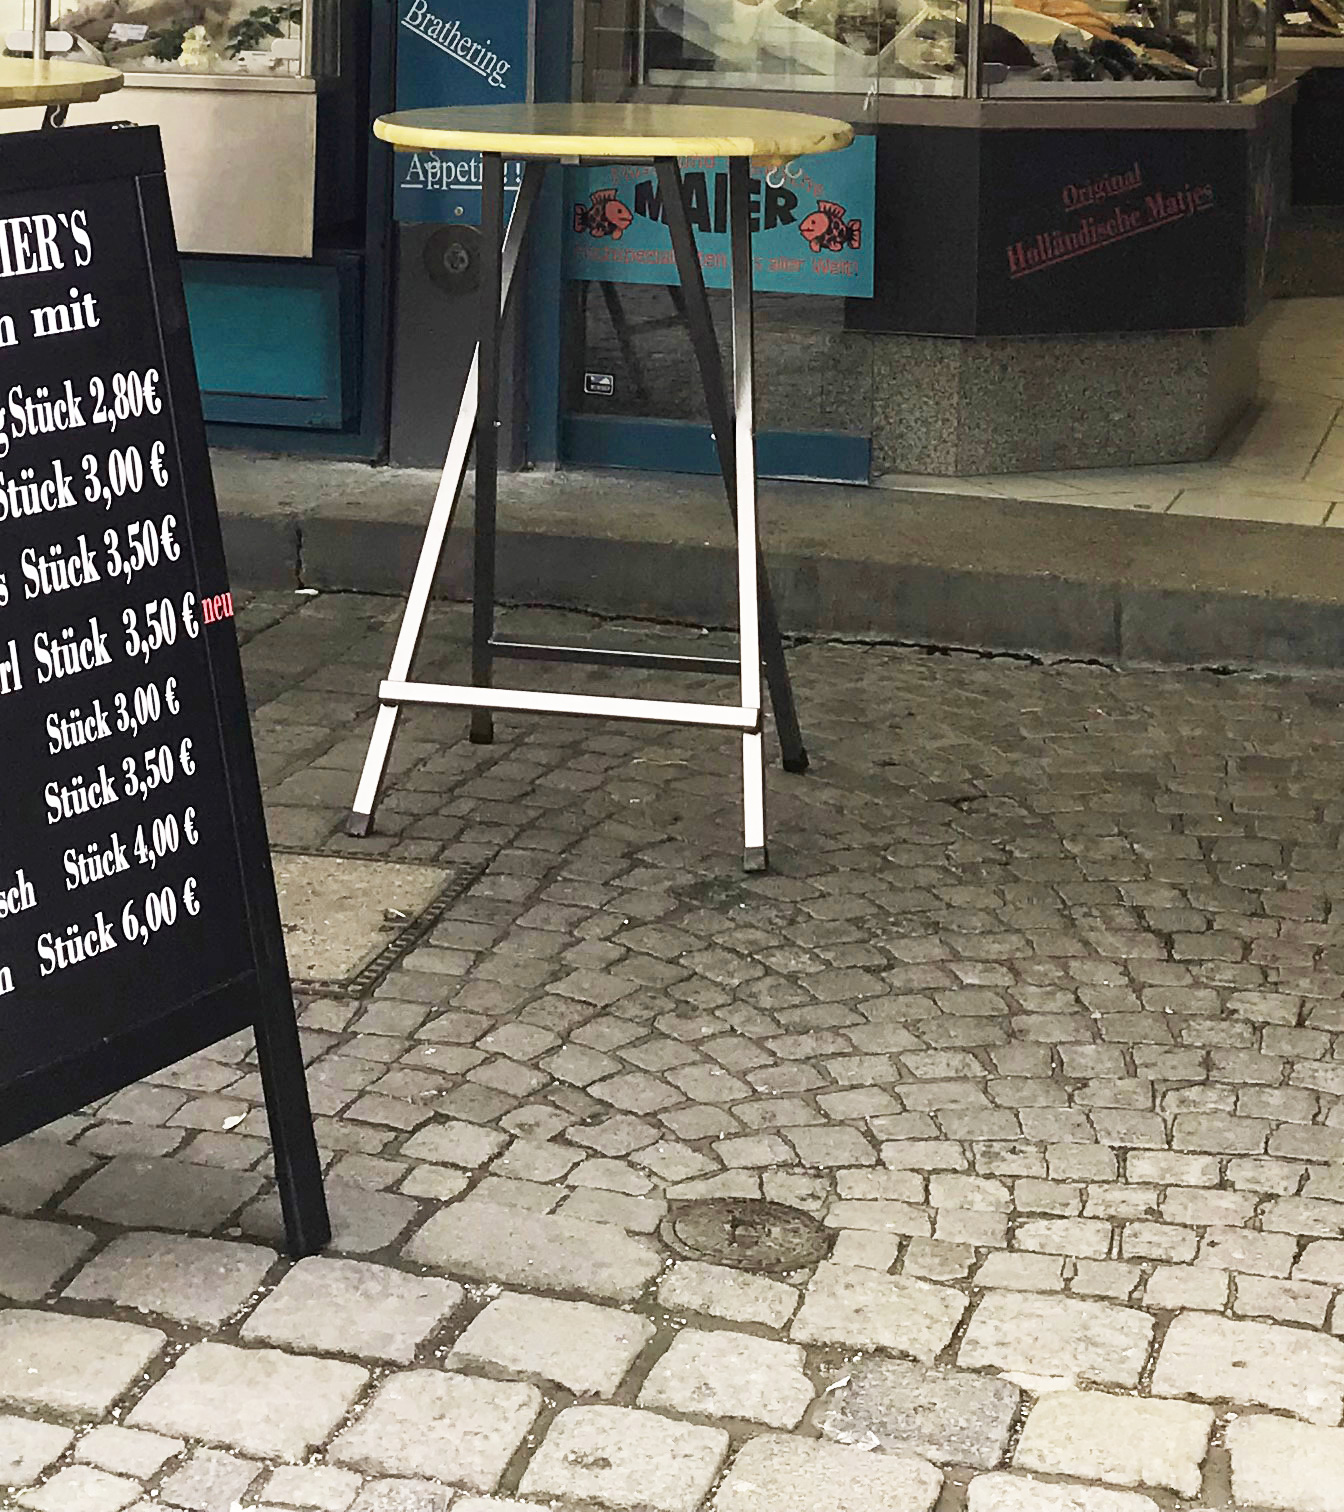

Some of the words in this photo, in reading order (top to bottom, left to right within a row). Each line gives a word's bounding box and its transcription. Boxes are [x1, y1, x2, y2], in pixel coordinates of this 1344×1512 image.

[405, 152, 485, 190] Appeti
[1062, 161, 1142, 206] Original
[1007, 206, 1142, 272] Holländische
[1144, 183, 1213, 223] Matjes
[33, 287, 101, 339] mit
[8, 380, 86, 440] Stück
[81, 445, 143, 511] 3,00
[21, 534, 101, 601] Stück
[33, 617, 113, 684] Stück
[122, 598, 177, 665] 3,50
[202, 591, 234, 624] neu
[45, 702, 112, 755] Stück
[114, 683, 158, 737] 3,00
[44, 765, 119, 824] Stück
[122, 745, 174, 800] 3,50
[63, 832, 128, 890] Stück
[133, 814, 179, 867] 4,00
[37, 911, 118, 976] Stück
[122, 886, 176, 945] 6,00
